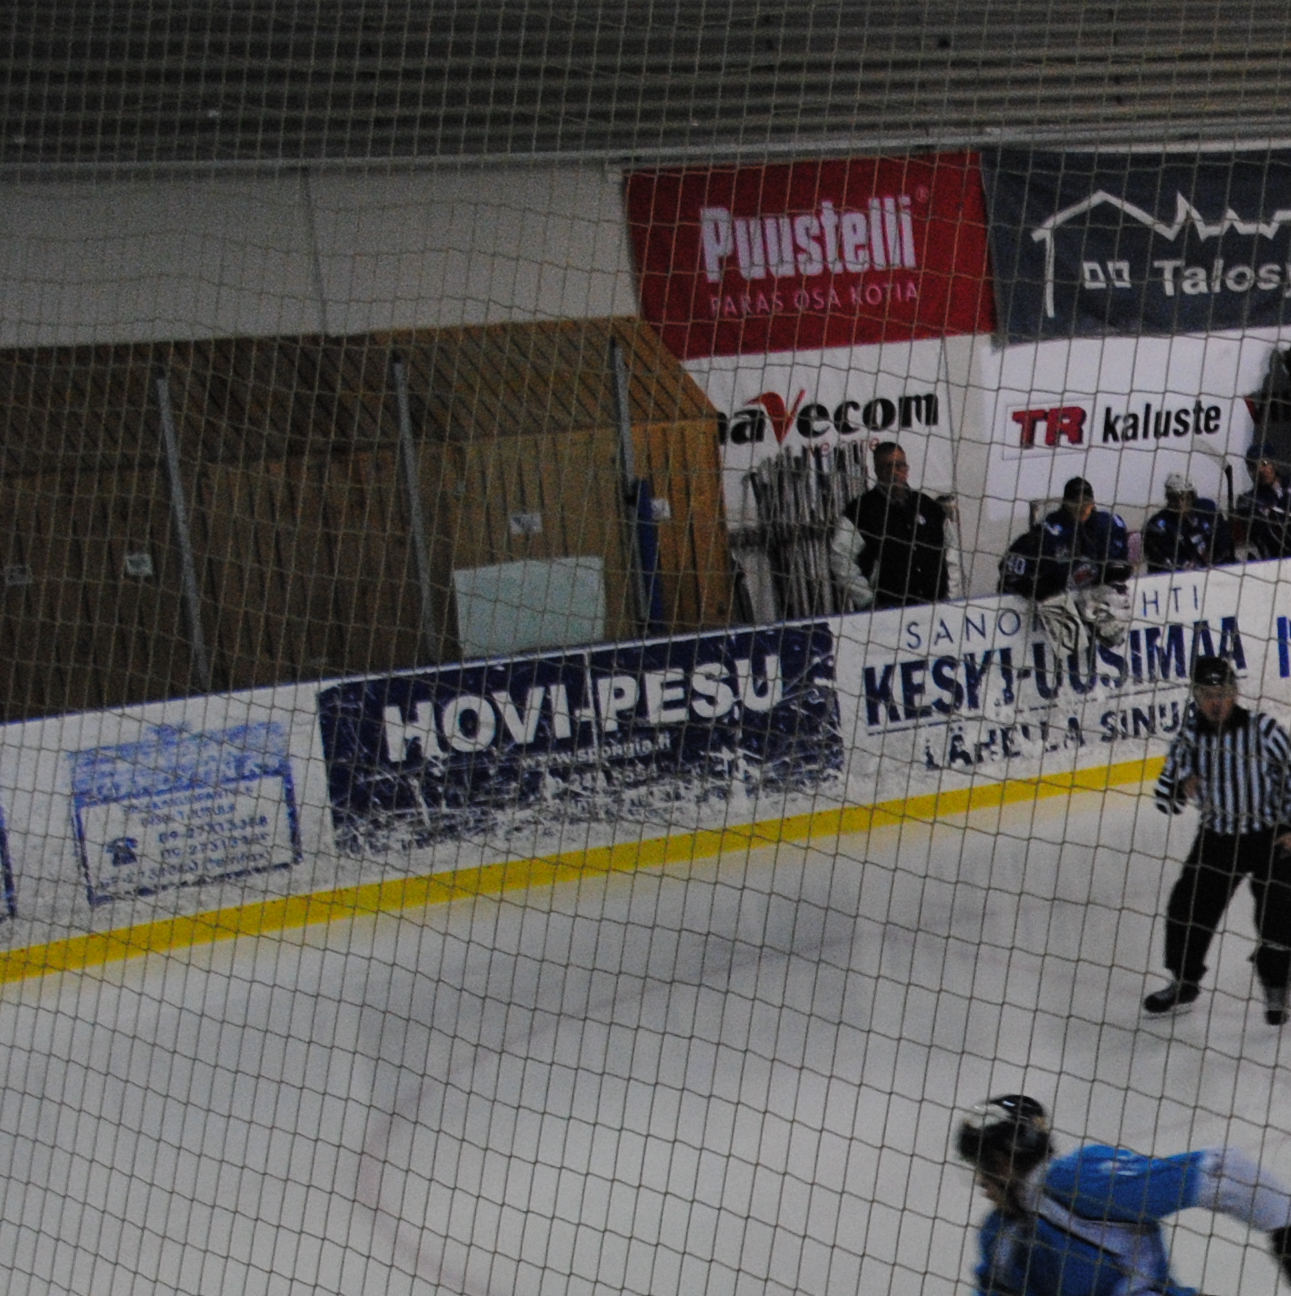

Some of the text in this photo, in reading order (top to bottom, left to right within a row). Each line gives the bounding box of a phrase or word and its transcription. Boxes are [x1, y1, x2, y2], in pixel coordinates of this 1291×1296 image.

[701, 194, 917, 284] Puustelli
[710, 281, 919, 317] PARAS OSA KOTIA
[1012, 401, 1222, 449] TR kaluste
[383, 654, 785, 764] HOVI-PESU
[1101, 698, 1198, 743] SINU
